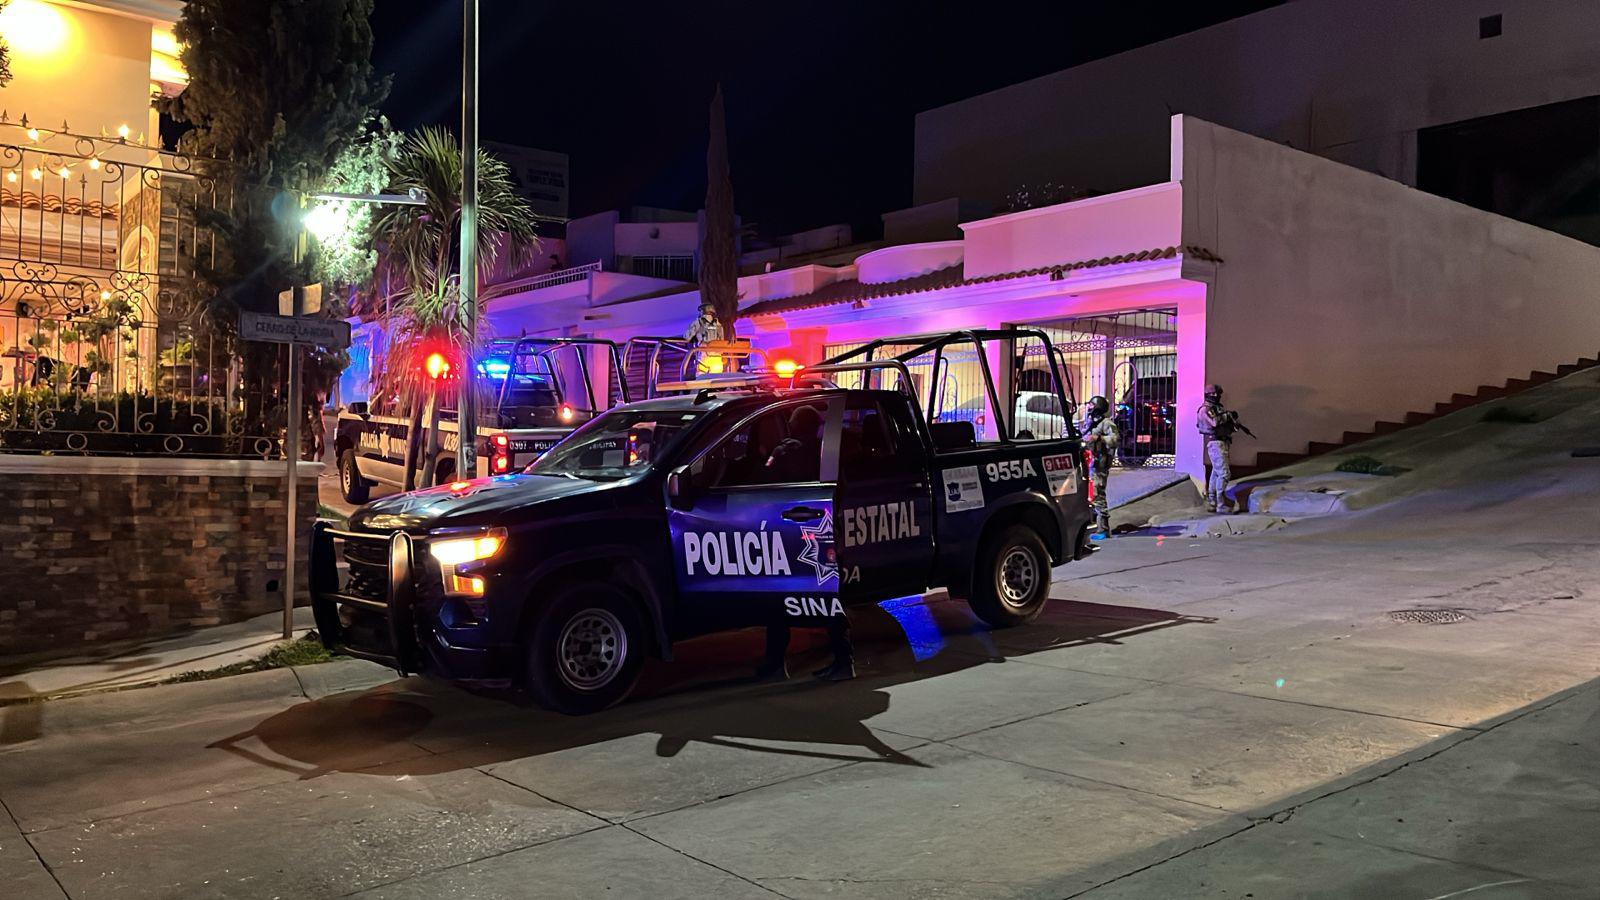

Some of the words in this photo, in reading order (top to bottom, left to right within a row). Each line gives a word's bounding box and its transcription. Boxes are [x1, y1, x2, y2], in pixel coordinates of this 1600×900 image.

[985, 458, 1038, 483] 955A
[683, 519, 792, 576] POLICÍA
[843, 500, 921, 548] ESTATAL
[783, 596, 847, 617] SINA
